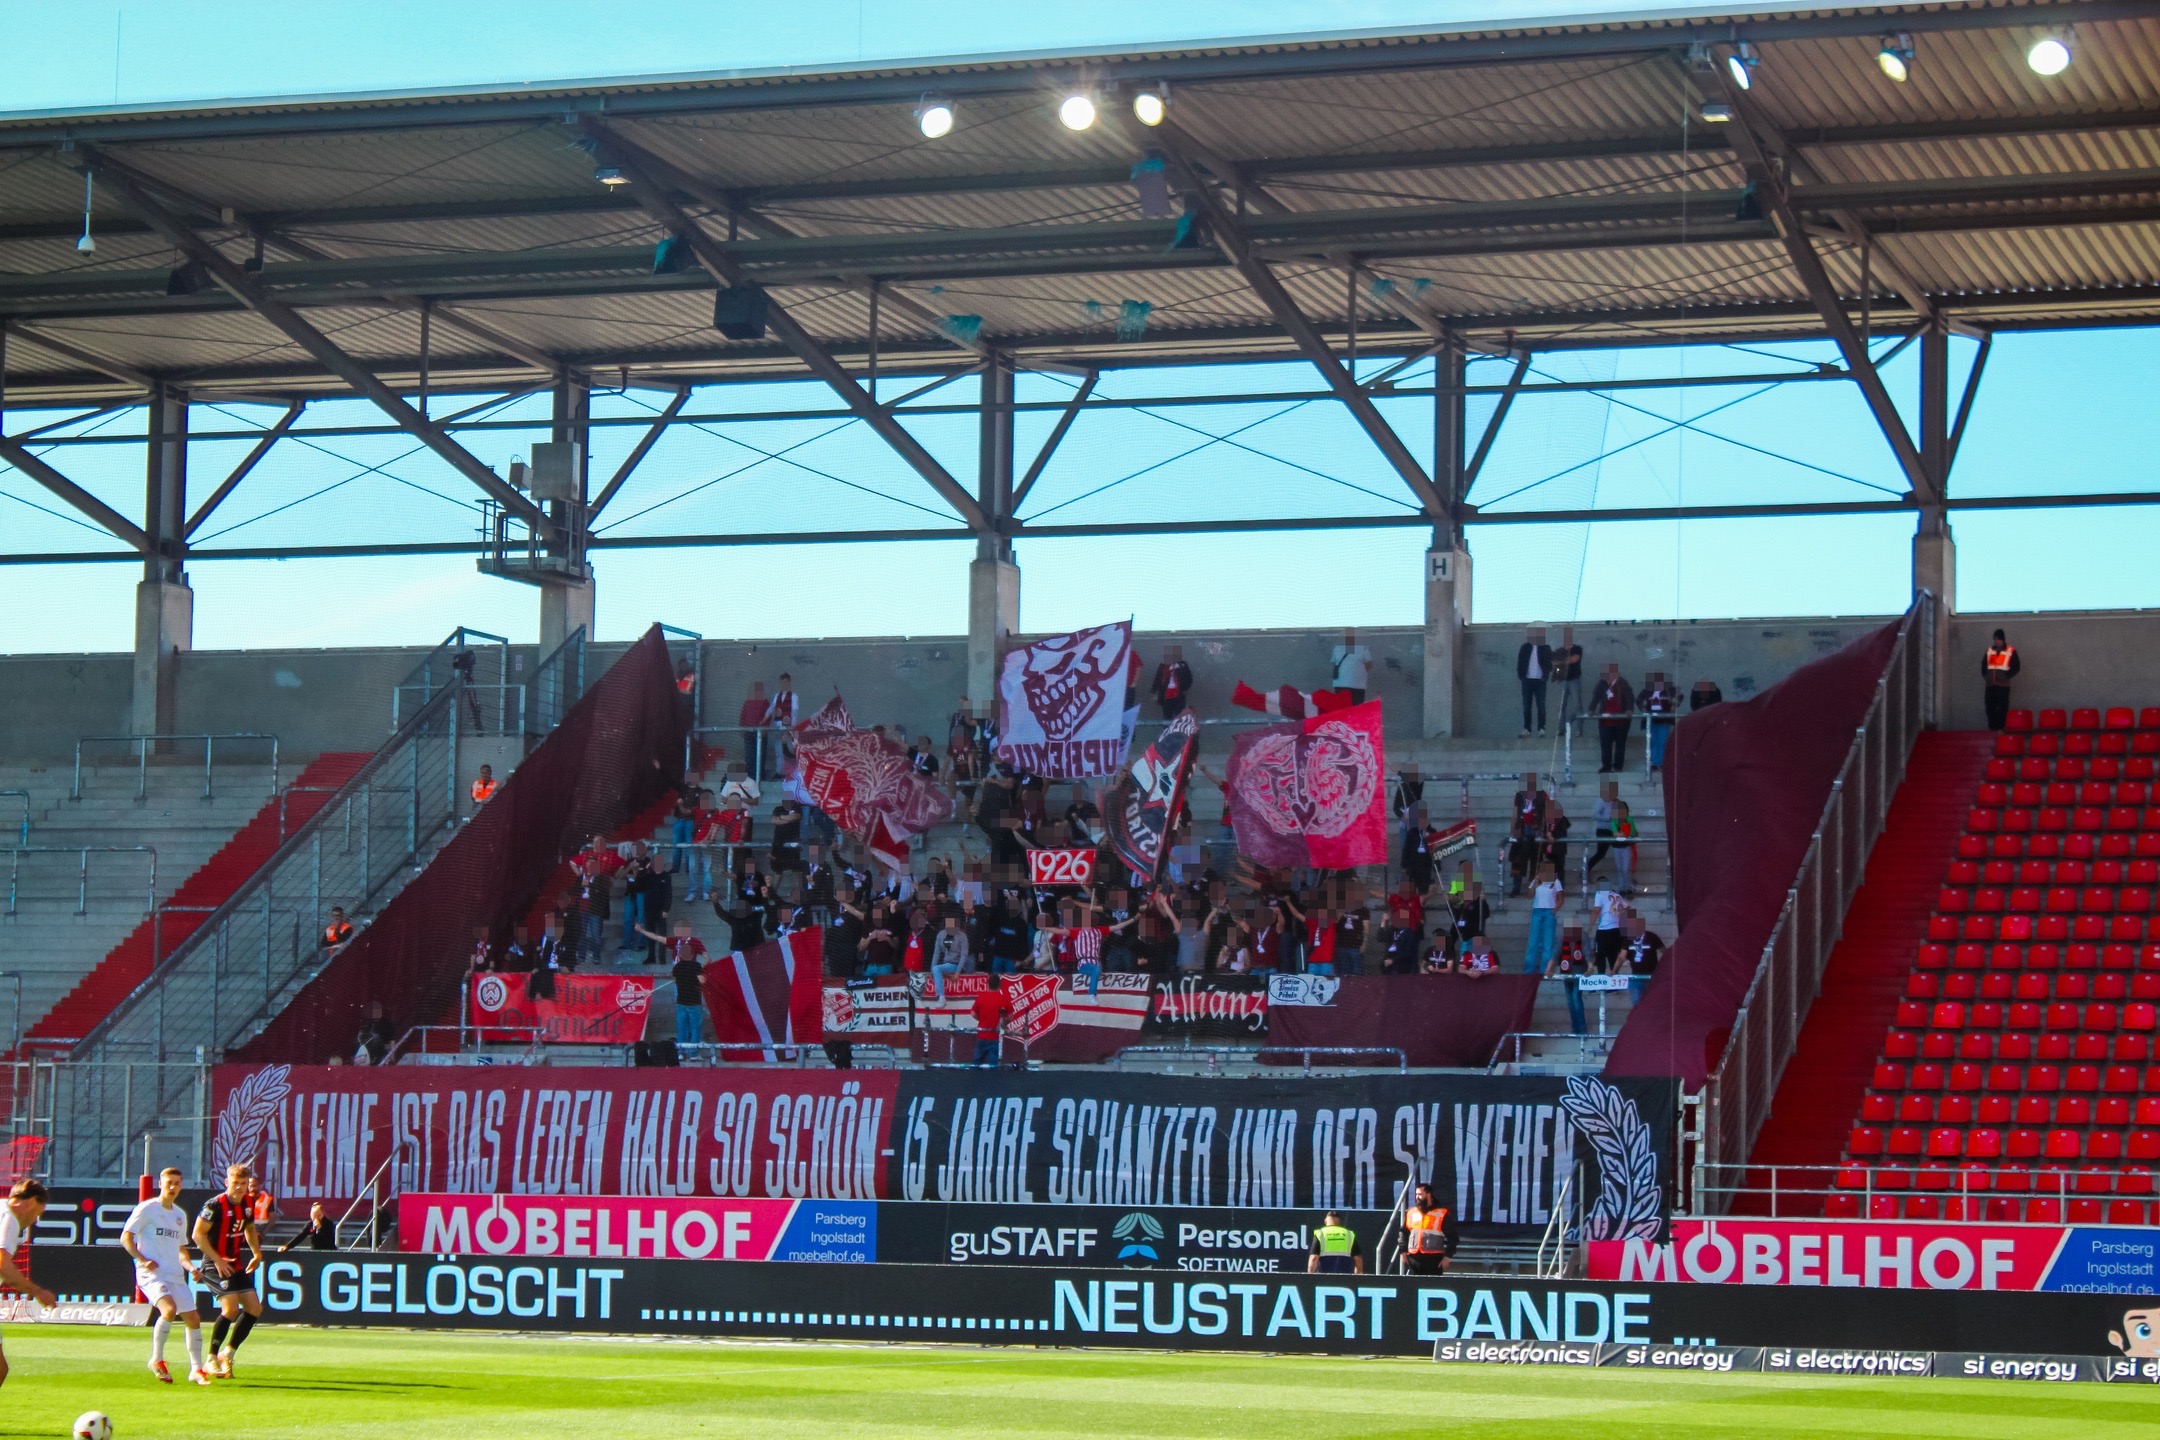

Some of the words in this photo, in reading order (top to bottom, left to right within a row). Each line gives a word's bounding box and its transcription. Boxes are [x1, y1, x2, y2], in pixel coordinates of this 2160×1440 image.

[1432, 558, 1446, 576] H
[1031, 851, 1090, 882] 1926
[863, 991, 909, 1002] WEHEN
[1008, 981, 1024, 999] SV
[867, 1015, 907, 1027] ALLER
[391, 1092, 439, 1193] IST
[447, 1089, 506, 1194] DAS
[512, 1088, 612, 1195] LEBEN
[620, 1090, 703, 1196] HALB
[710, 1092, 757, 1197] SO
[902, 1096, 935, 1201] 15
[938, 1097, 1043, 1202] JAHRE
[1049, 1097, 1217, 1206] SCHANZER
[1227, 1108, 1297, 1208] UND
[1312, 1107, 1377, 1209] DER
[1392, 1102, 1440, 1206] SV
[1454, 1103, 1576, 1225] WEHEN
[815, 1213, 866, 1228] Parsberg
[811, 1231, 865, 1246] Ingolstadt
[950, 1226, 1098, 1262] guSTAFF
[1178, 1223, 1309, 1250] Personal
[788, 1250, 865, 1262] moebelhof.de
[2092, 1240, 2154, 1257] Parsberg
[1177, 1257, 1280, 1273] SOFTWARE
[2087, 1261, 2154, 1277] Ingolstadt
[320, 1254, 624, 1319] GELÖSCHT
[2061, 1283, 2154, 1295] moebelhofde
[60, 1303, 128, 1325] energy
[1054, 1280, 1397, 1340] NEUSTART
[1417, 1288, 1652, 1346] BANDE
[1441, 1342, 1462, 1360] si
[1466, 1342, 1590, 1364] electronics
[1626, 1346, 1647, 1363] si
[1651, 1350, 1734, 1371] energy
[1769, 1349, 1792, 1368] si
[1796, 1349, 1926, 1372] electronics
[1963, 1356, 1986, 1374] si
[1990, 1360, 2078, 1382] energy
